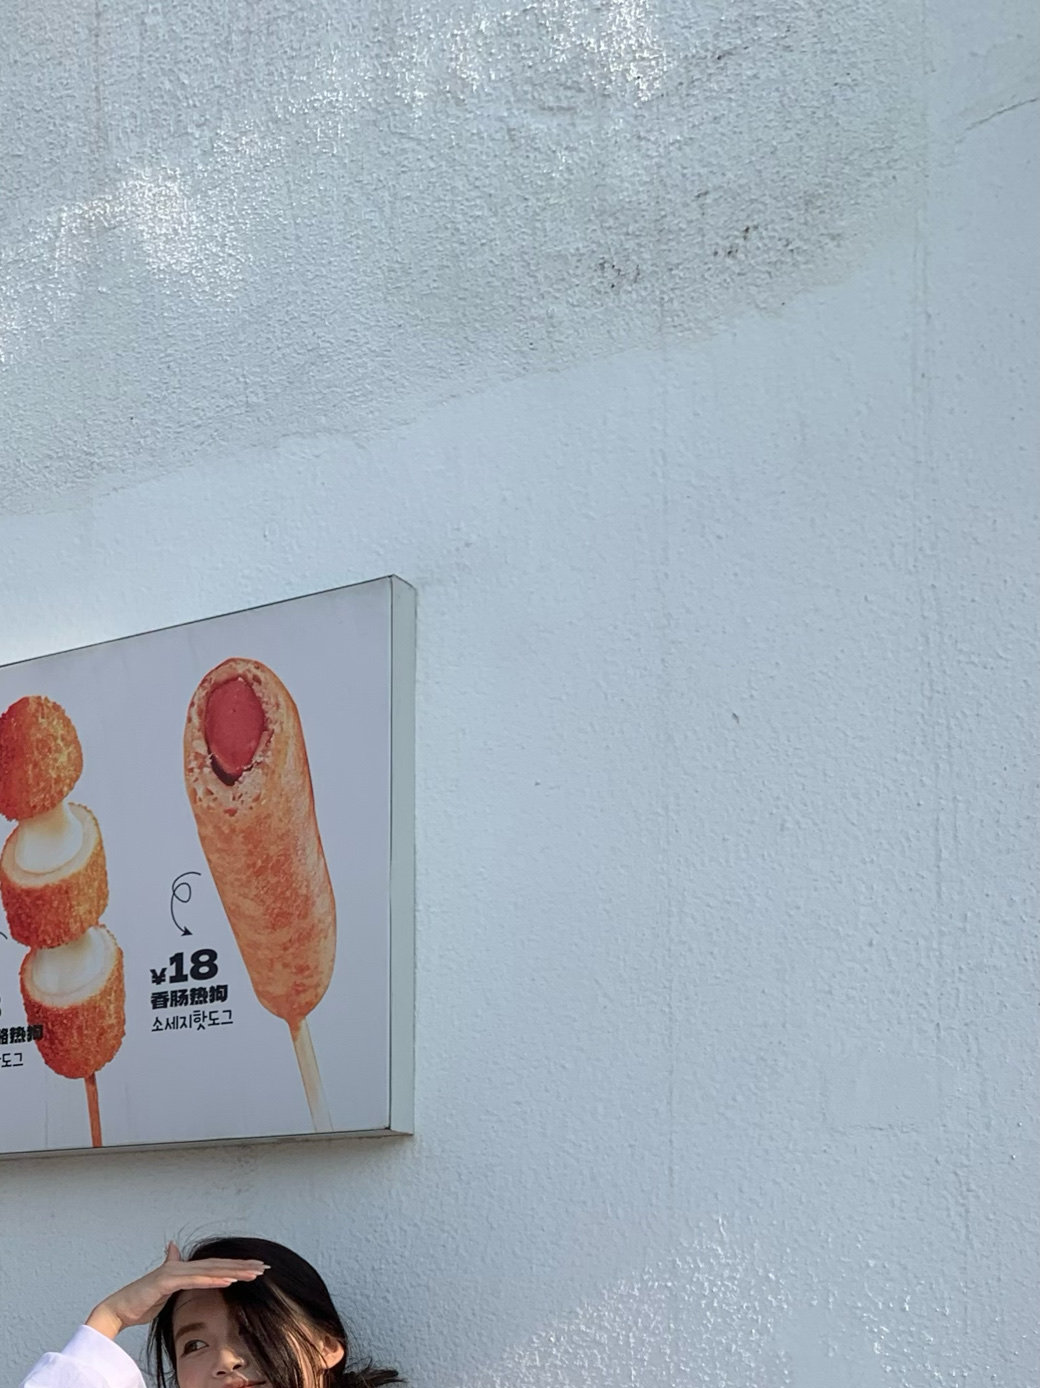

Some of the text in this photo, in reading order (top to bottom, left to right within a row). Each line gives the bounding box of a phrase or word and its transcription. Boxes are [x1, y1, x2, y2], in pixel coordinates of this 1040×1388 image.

[150, 949, 218, 985] ¥18
[150, 984, 228, 1010] 香肠热狗
[151, 1009, 233, 1031] 소세지핫도그
